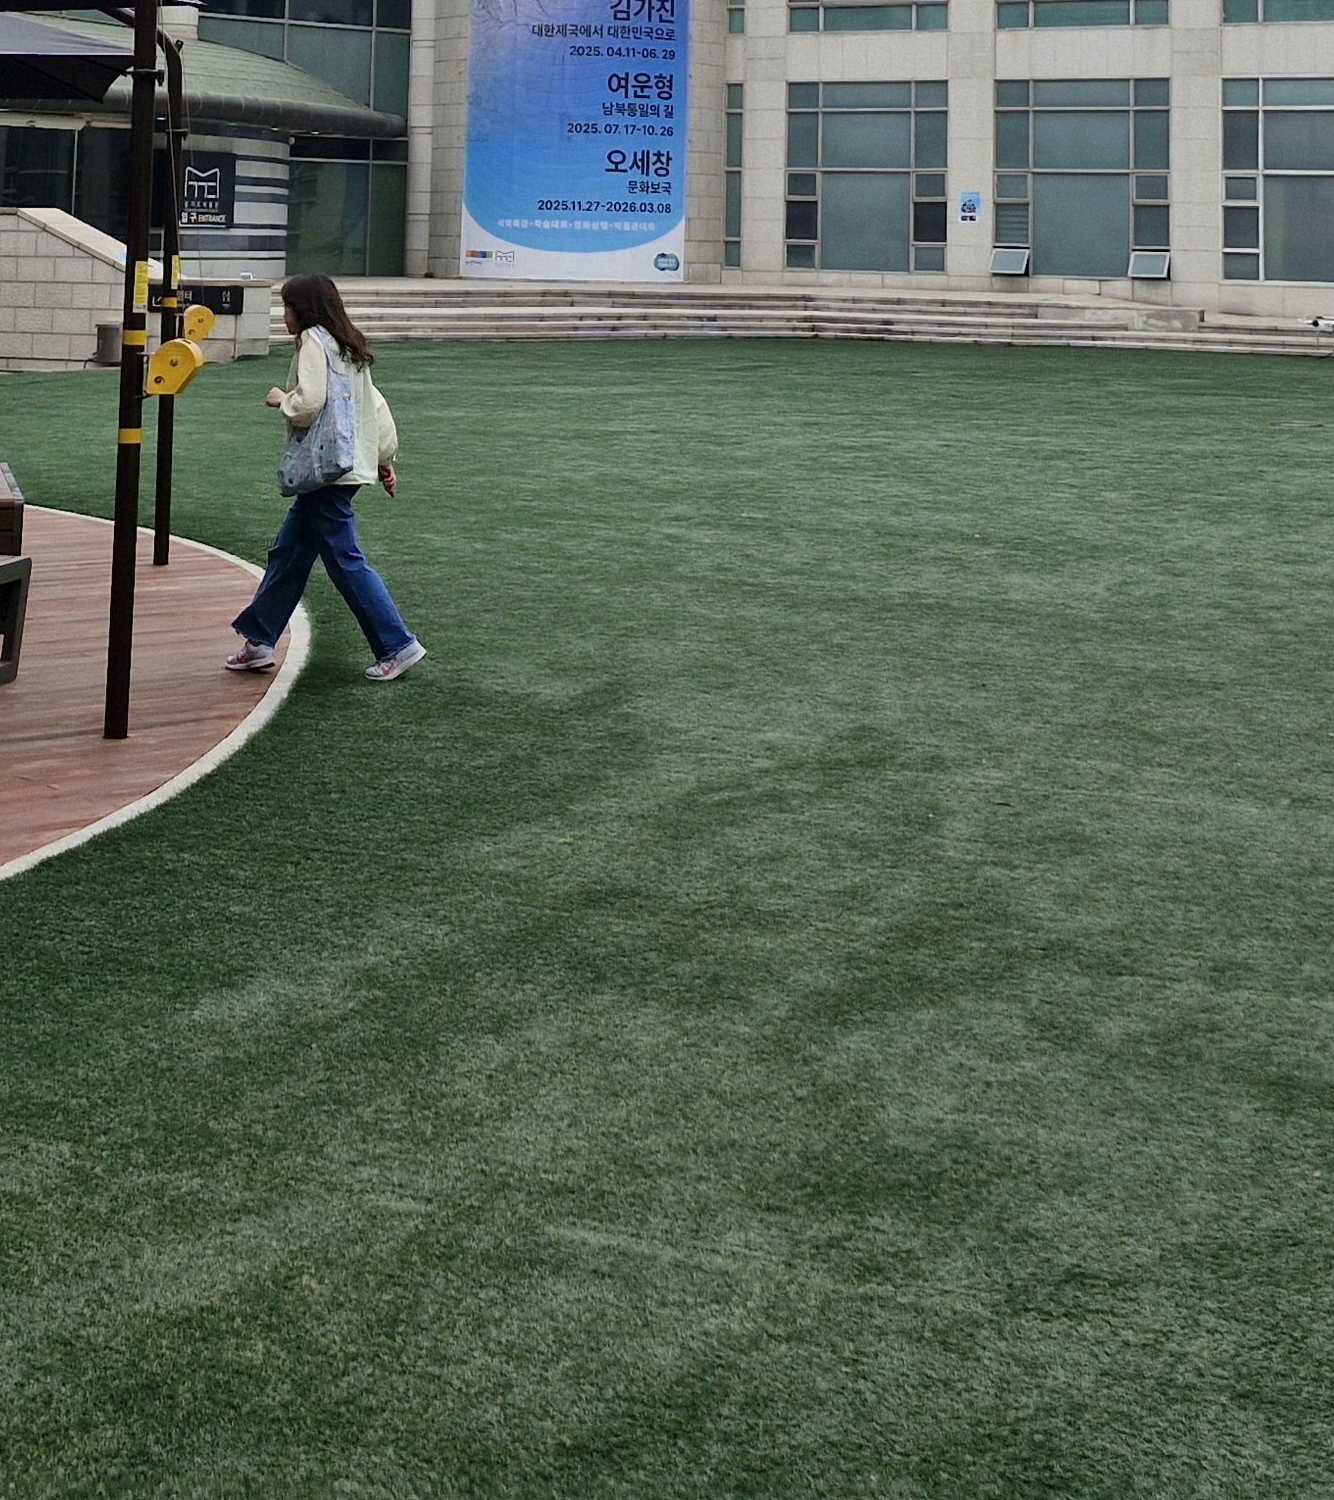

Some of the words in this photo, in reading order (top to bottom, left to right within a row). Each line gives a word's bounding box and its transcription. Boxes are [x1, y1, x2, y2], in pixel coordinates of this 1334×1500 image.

[532, 23, 604, 39] 대한제국에서
[607, 25, 676, 41] 대한민국으로
[607, 71, 674, 101] 여운형
[602, 102, 660, 118] 남북통일의
[663, 104, 674, 119] 길
[605, 149, 673, 177] 오세창
[627, 180, 673, 196] 문화보국
